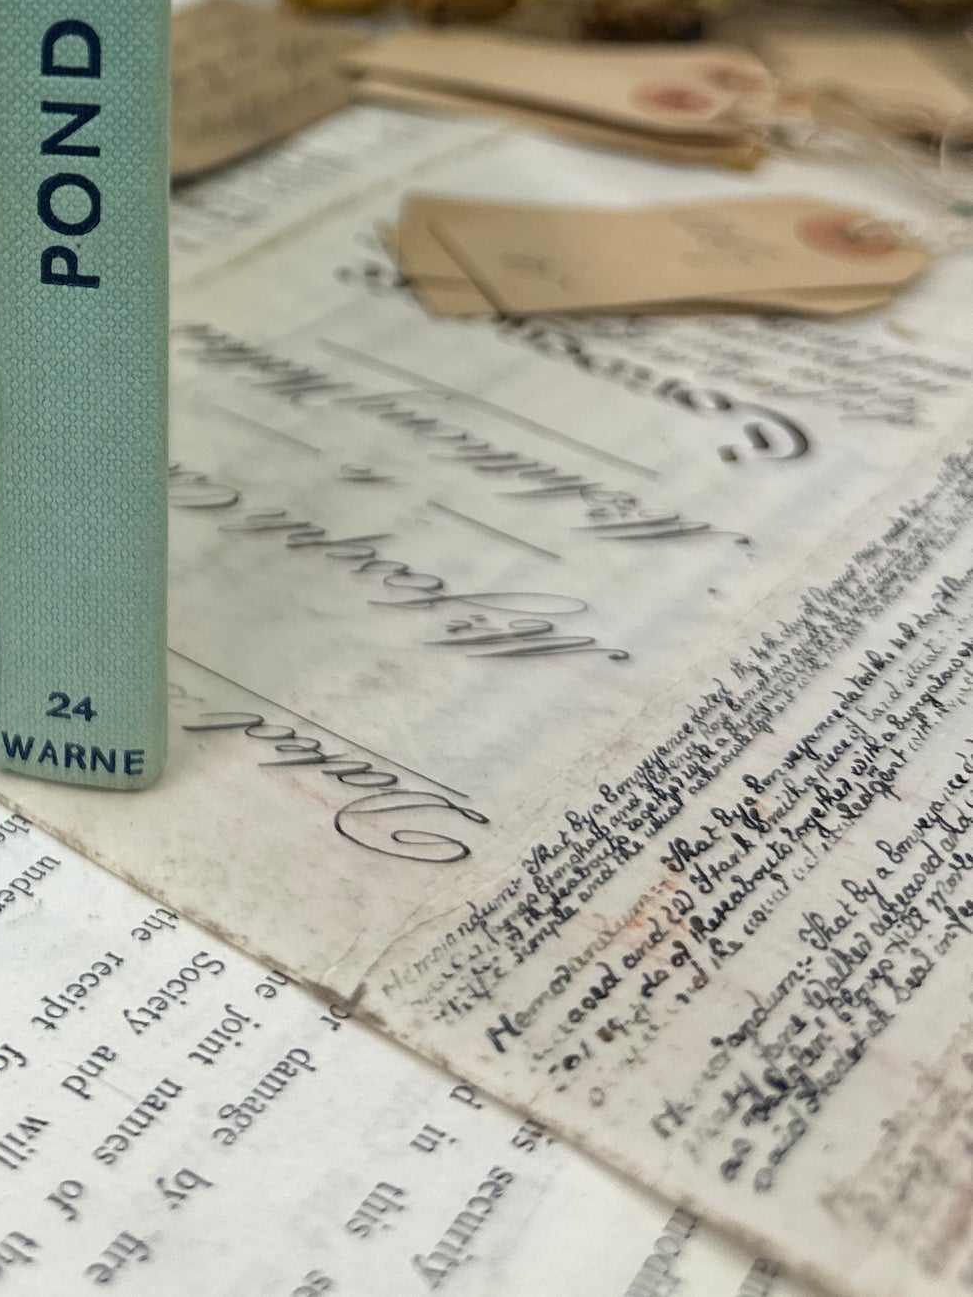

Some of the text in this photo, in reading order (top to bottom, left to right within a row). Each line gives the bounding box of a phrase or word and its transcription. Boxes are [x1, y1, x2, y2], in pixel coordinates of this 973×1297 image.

[37, 19, 102, 289] POND
[45, 691, 98, 722] 24
[1, 730, 145, 776] WARNE
[181, 708, 489, 865] Dated
[521, 830, 572, 879] That
[660, 825, 723, 875] That
[130, 908, 178, 944] the
[798, 899, 858, 951] That
[841, 879, 885, 905] by
[876, 867, 895, 880] a
[622, 917, 670, 970] and
[30, 950, 125, 1031] receipt
[124, 950, 224, 1035] Society
[187, 1003, 262, 1066] joint
[59, 1044, 119, 1102] and
[210, 1047, 318, 1148] damage
[91, 1077, 185, 1167] names
[44, 1179, 87, 1223] of
[154, 1167, 215, 1211] by
[344, 1123, 460, 1240] in this
[84, 1229, 157, 1288] fire
[412, 1165, 516, 1292] security
